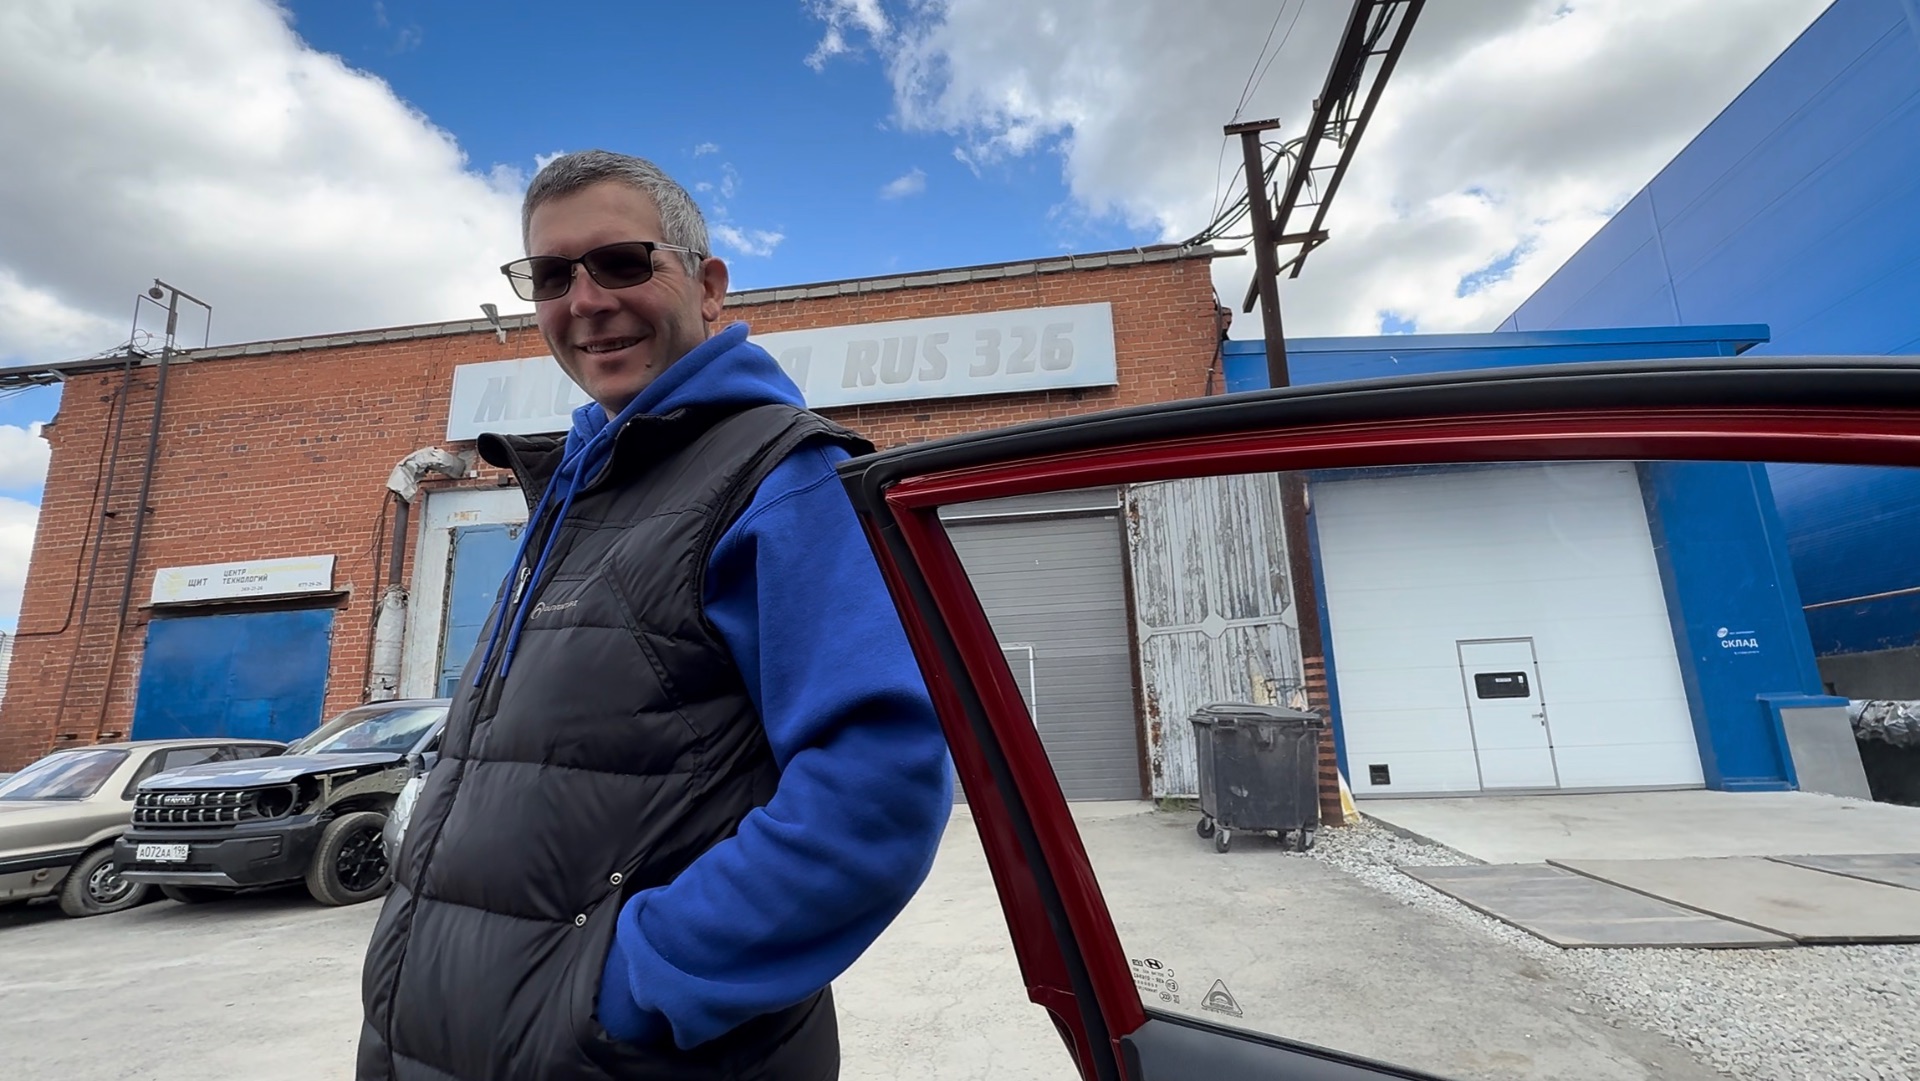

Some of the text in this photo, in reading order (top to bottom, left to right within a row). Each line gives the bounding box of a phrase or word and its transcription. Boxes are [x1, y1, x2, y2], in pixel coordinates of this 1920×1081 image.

[841, 332, 949, 389] RUS
[968, 323, 1074, 378] 326
[223, 569, 247, 577] ЦЕНТР
[188, 578, 208, 587] ЩИТ
[223, 574, 268, 585] ТЕХНОЛОГИЙ
[1721, 638, 1759, 648] СКЛАД
